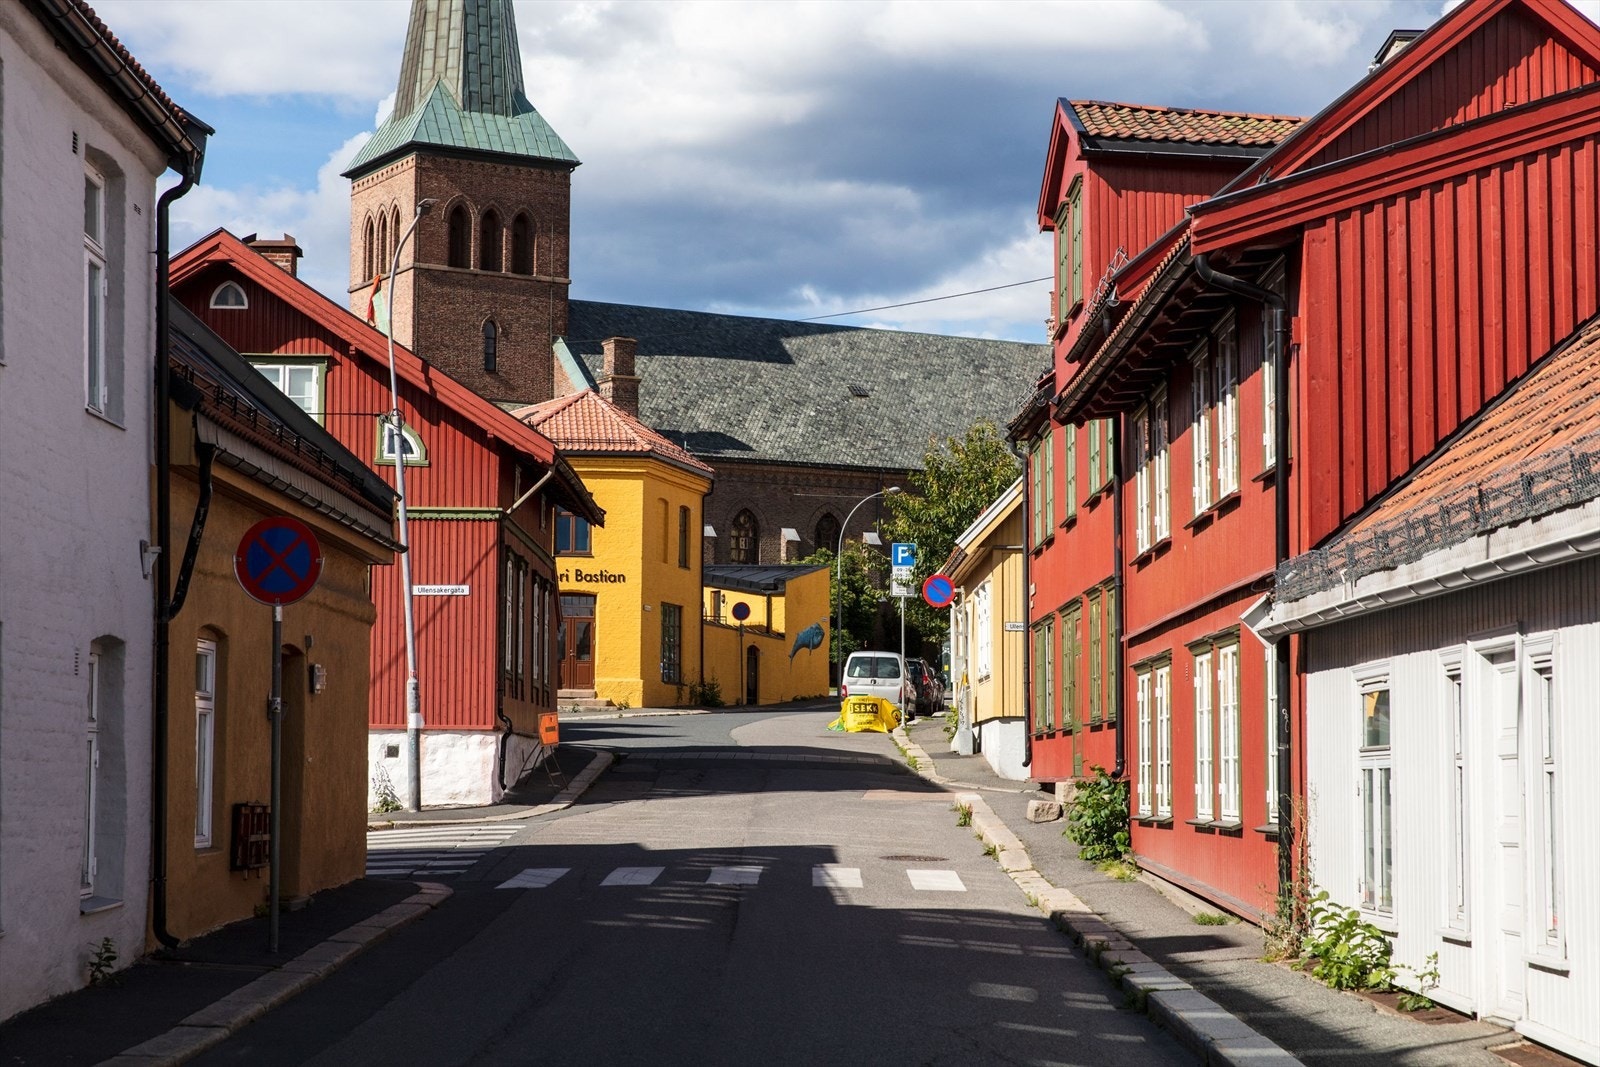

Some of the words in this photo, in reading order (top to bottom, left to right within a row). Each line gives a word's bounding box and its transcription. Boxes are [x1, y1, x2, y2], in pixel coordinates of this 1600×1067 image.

[897, 546, 910, 564] P
[575, 568, 626, 583] Bastian
[417, 586, 465, 595] Ullensakergata
